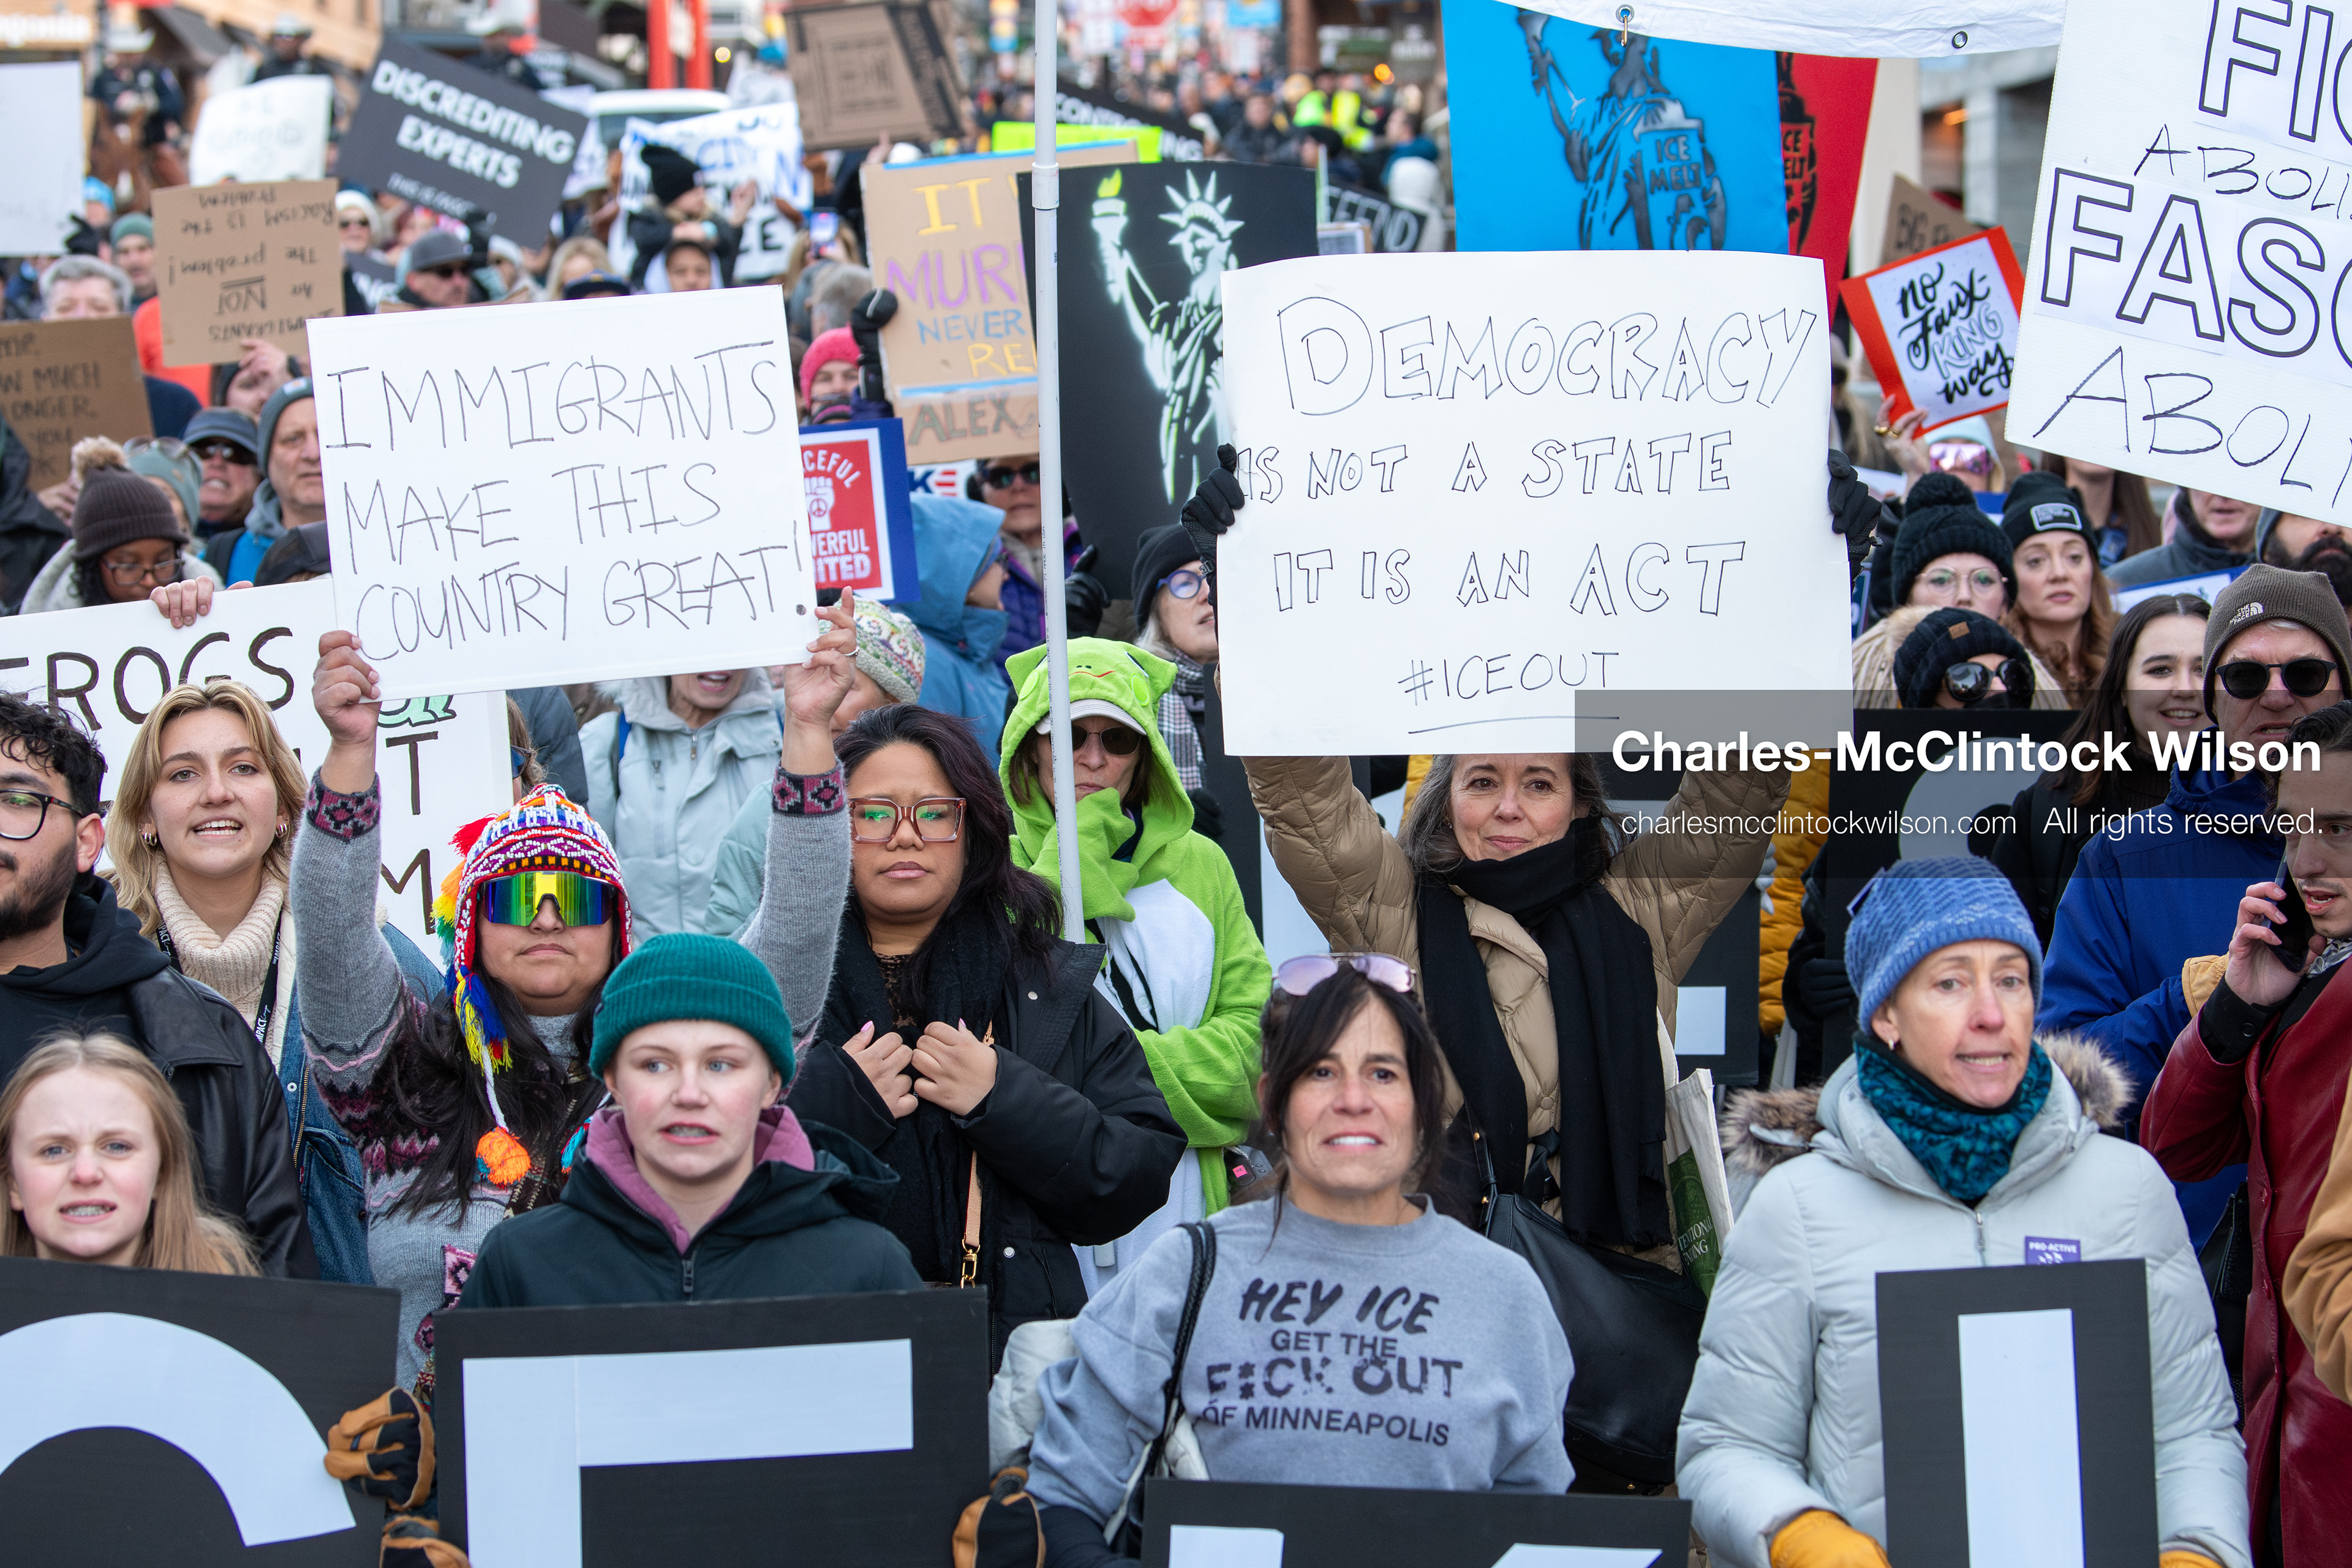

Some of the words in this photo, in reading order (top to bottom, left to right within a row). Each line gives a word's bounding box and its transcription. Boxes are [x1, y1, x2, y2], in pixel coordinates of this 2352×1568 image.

[371, 59, 576, 164] DISCREDITING
[396, 114, 523, 189] EXPERTS
[1656, 135, 1691, 162] ICE
[1783, 129, 1803, 153] CE
[1649, 163, 1702, 194] MELT
[1784, 156, 1806, 181] ELT
[2133, 123, 2352, 220] ABOLI
[887, 241, 1027, 309] MUR
[213, 285, 266, 316] NOT
[916, 309, 1027, 345] NEVER
[1932, 301, 2004, 380] KING
[967, 339, 1038, 379] RE
[1277, 296, 1817, 416] DEMOCRACY
[326, 340, 777, 451] IMMIGRANTS
[908, 390, 1018, 446] ALEX
[801, 449, 861, 489] CEFUL
[1237, 447, 1283, 503] IS
[1308, 445, 1408, 500] NOT
[1452, 442, 1488, 492] A
[1522, 429, 1732, 499] STATE
[344, 479, 519, 575] MAKE
[552, 462, 720, 545] THIS
[813, 552, 872, 584] ITED
[1273, 548, 1333, 612] IT
[1361, 548, 1411, 605] IS
[1457, 549, 1530, 608] AN
[1570, 541, 1746, 617] ACT
[356, 561, 568, 660] COUNTRY
[603, 520, 807, 630] GREAT!
[2236, 603, 2250, 613] THE
[2229, 608, 2250, 625] NORTH
[2233, 612, 2250, 625] FACE
[1398, 651, 1621, 706] #ICEOUT
[255, 1017, 267, 1042] MPACT
[2029, 1241, 2078, 1254] PRO-ACTIVE
[1238, 1277, 1343, 1326] HEY
[1355, 1286, 1440, 1335] ICE
[1270, 1329, 1331, 1353] GET
[1340, 1333, 1398, 1359] THE
[1352, 1355, 1463, 1398] OUT
[1245, 1406, 1450, 1447] MINNEAPOLIS
